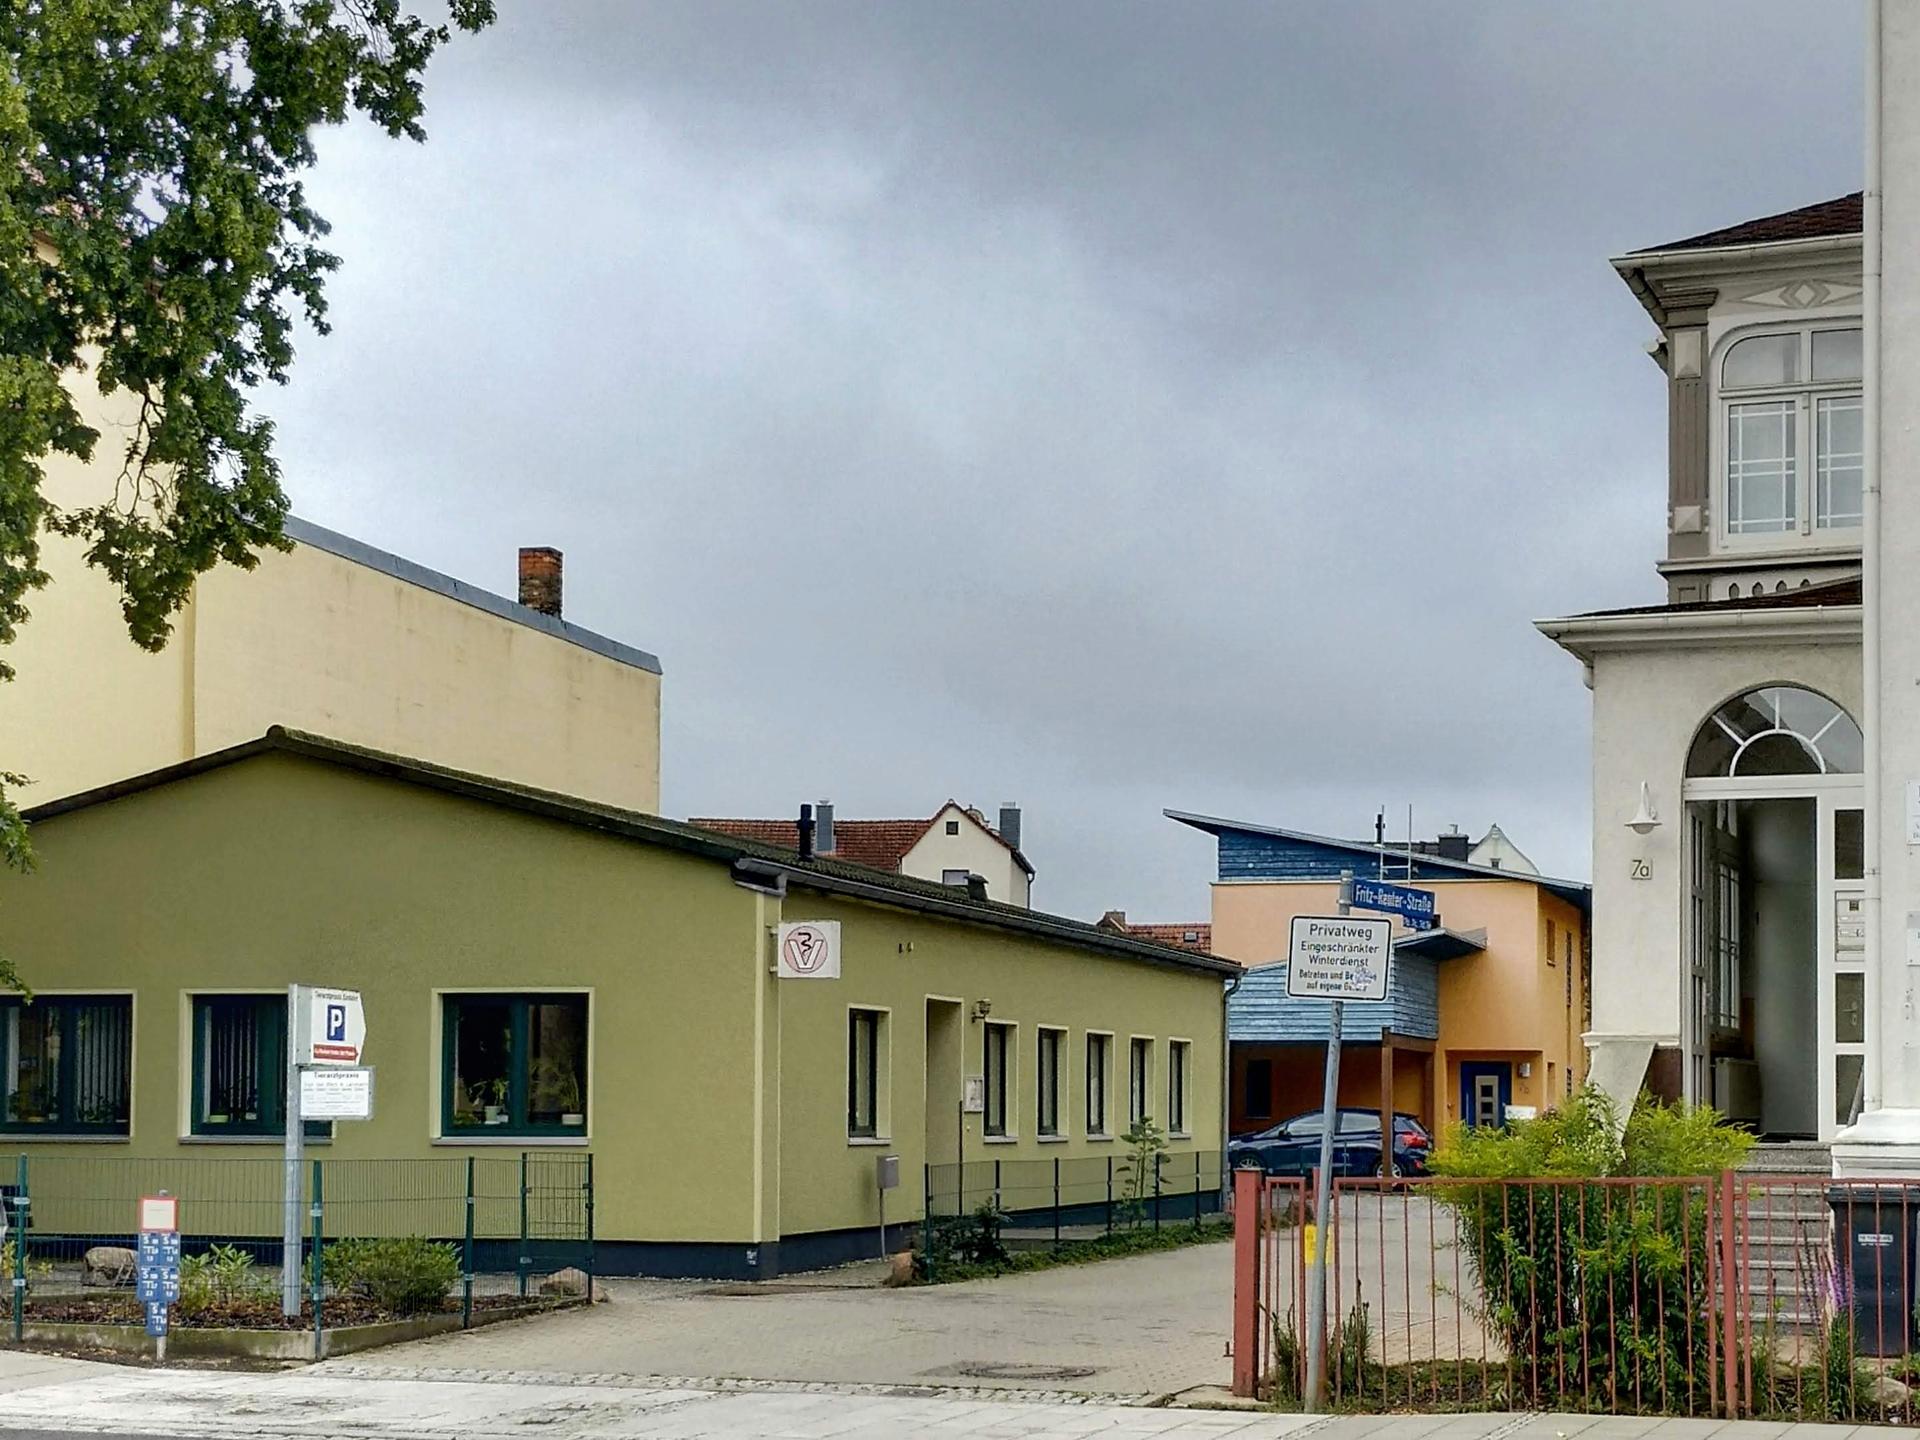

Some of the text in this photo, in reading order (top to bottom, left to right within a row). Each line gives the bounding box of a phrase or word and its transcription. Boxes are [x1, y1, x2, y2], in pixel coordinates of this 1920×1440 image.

[1632, 859, 1649, 877] 7a
[1309, 923, 1373, 941] Privatweg
[1301, 940, 1380, 954] Eingeschränkter
[1308, 954, 1369, 967] Winterdienst
[1330, 971, 1344, 980] und
[330, 1008, 343, 1037] P
